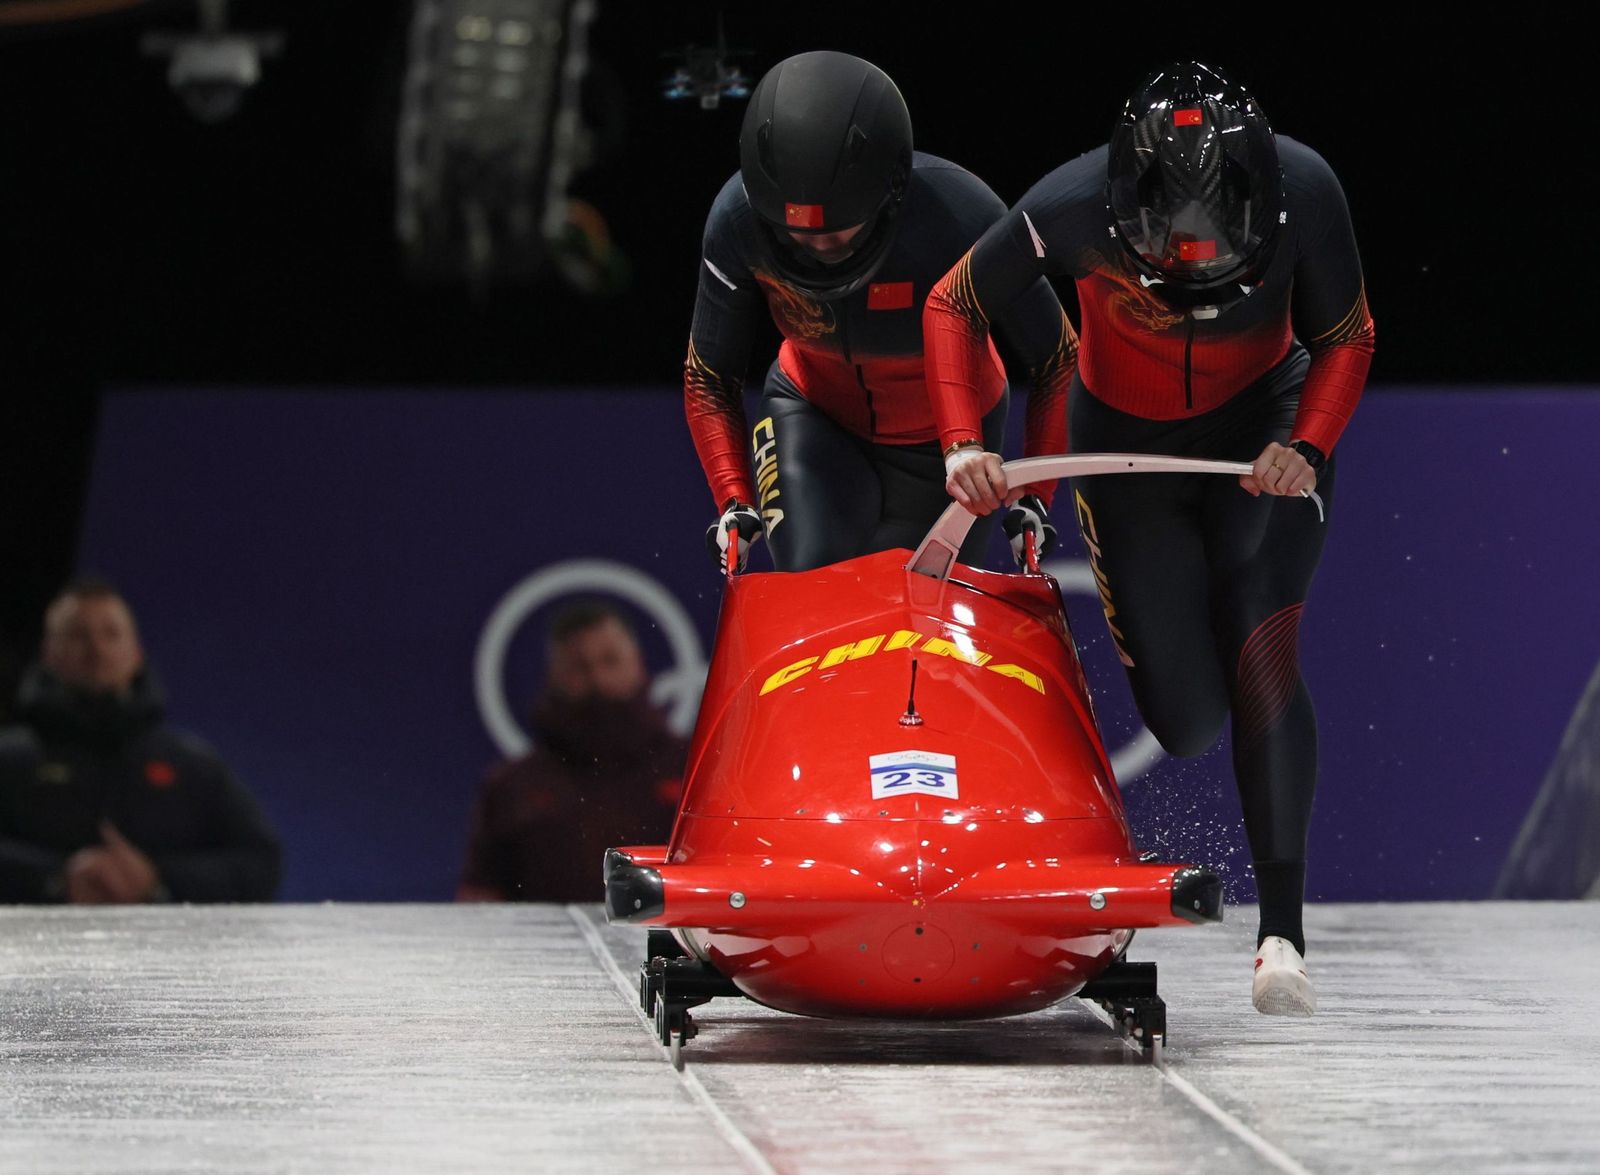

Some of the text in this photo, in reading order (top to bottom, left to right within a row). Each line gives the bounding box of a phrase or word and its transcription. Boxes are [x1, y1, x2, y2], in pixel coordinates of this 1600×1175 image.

[753, 417, 784, 539] CHINA
[759, 629, 1045, 696] CHINA
[883, 772, 945, 789] 23
